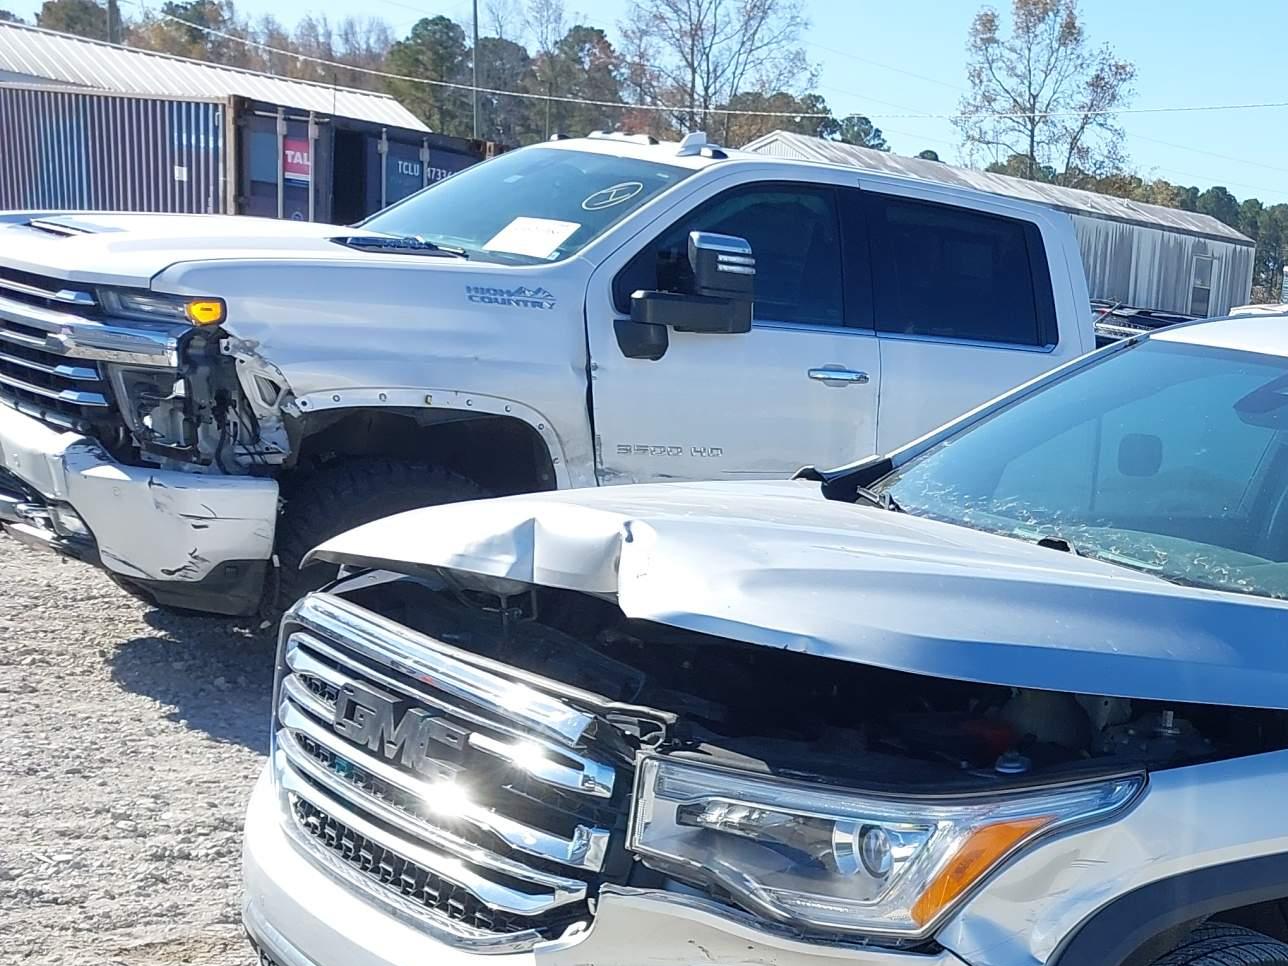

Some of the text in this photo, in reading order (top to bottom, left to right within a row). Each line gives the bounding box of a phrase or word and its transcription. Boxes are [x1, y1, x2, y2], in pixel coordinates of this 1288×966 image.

[285, 150, 311, 165] TAL
[398, 160, 420, 177] TCLU
[465, 285, 513, 297] HIGH
[467, 295, 557, 310] COUNTRY
[616, 444, 723, 457] 3500 HD
[333, 680, 475, 782] GMC
